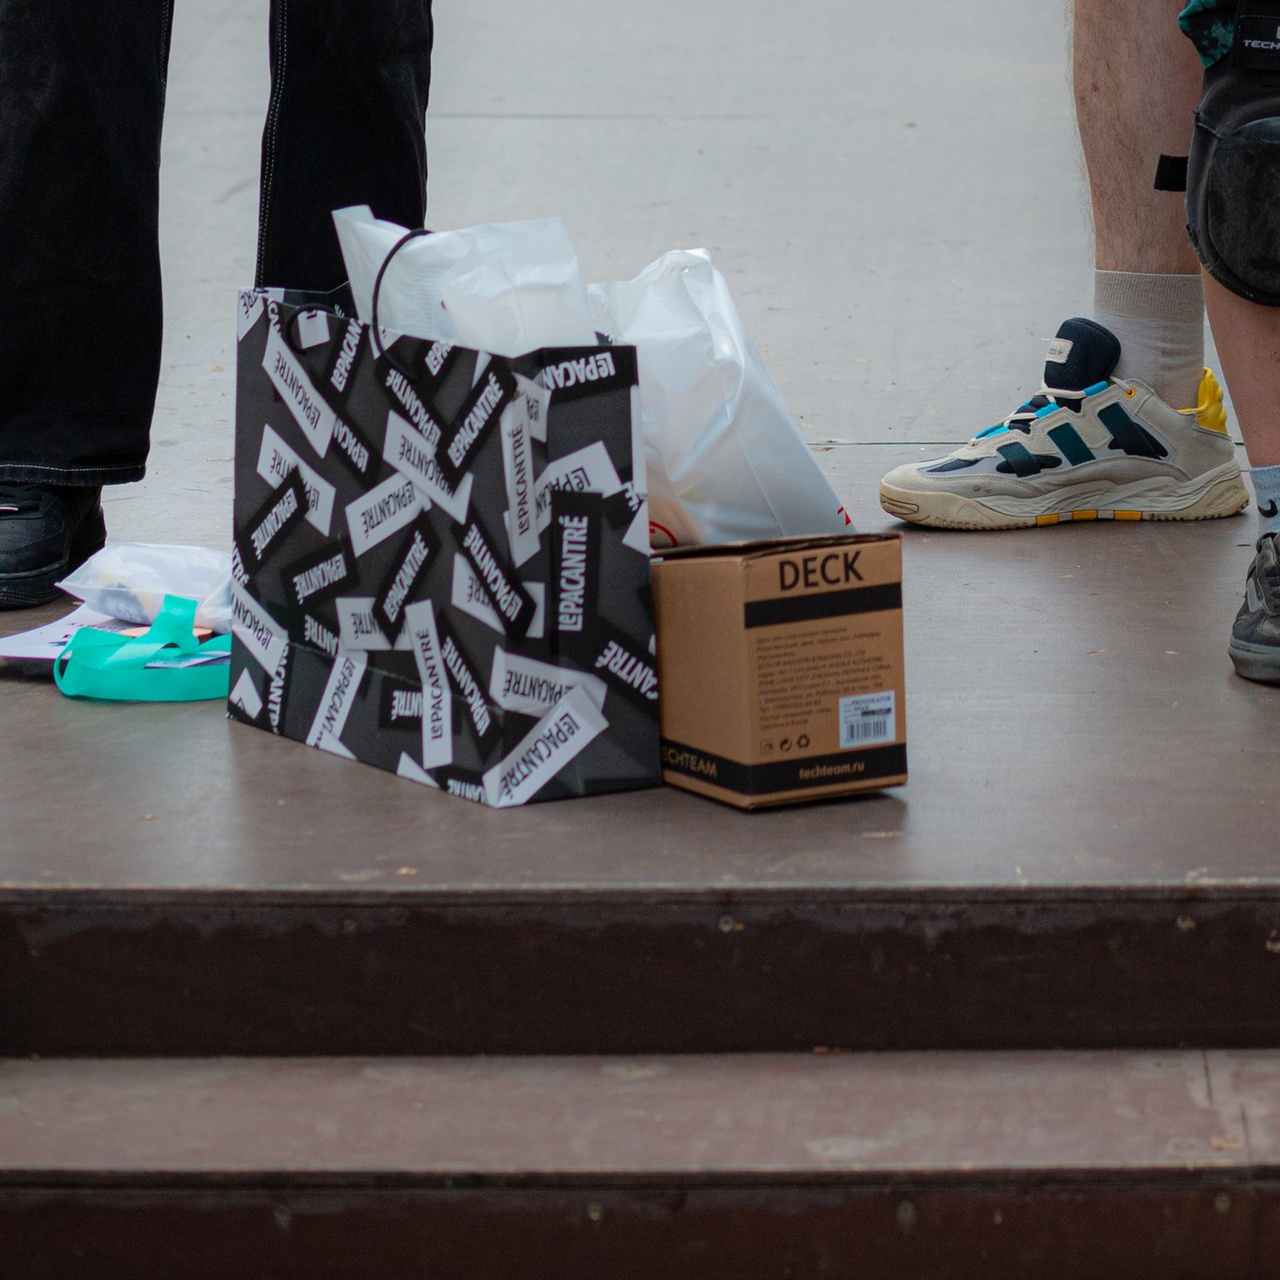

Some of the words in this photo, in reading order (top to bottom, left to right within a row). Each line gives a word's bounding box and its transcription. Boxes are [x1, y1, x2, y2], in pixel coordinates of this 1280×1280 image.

[1242, 39, 1280, 50] TECH
[778, 550, 864, 591] DECK
[799, 761, 865, 780] techteam.ru
